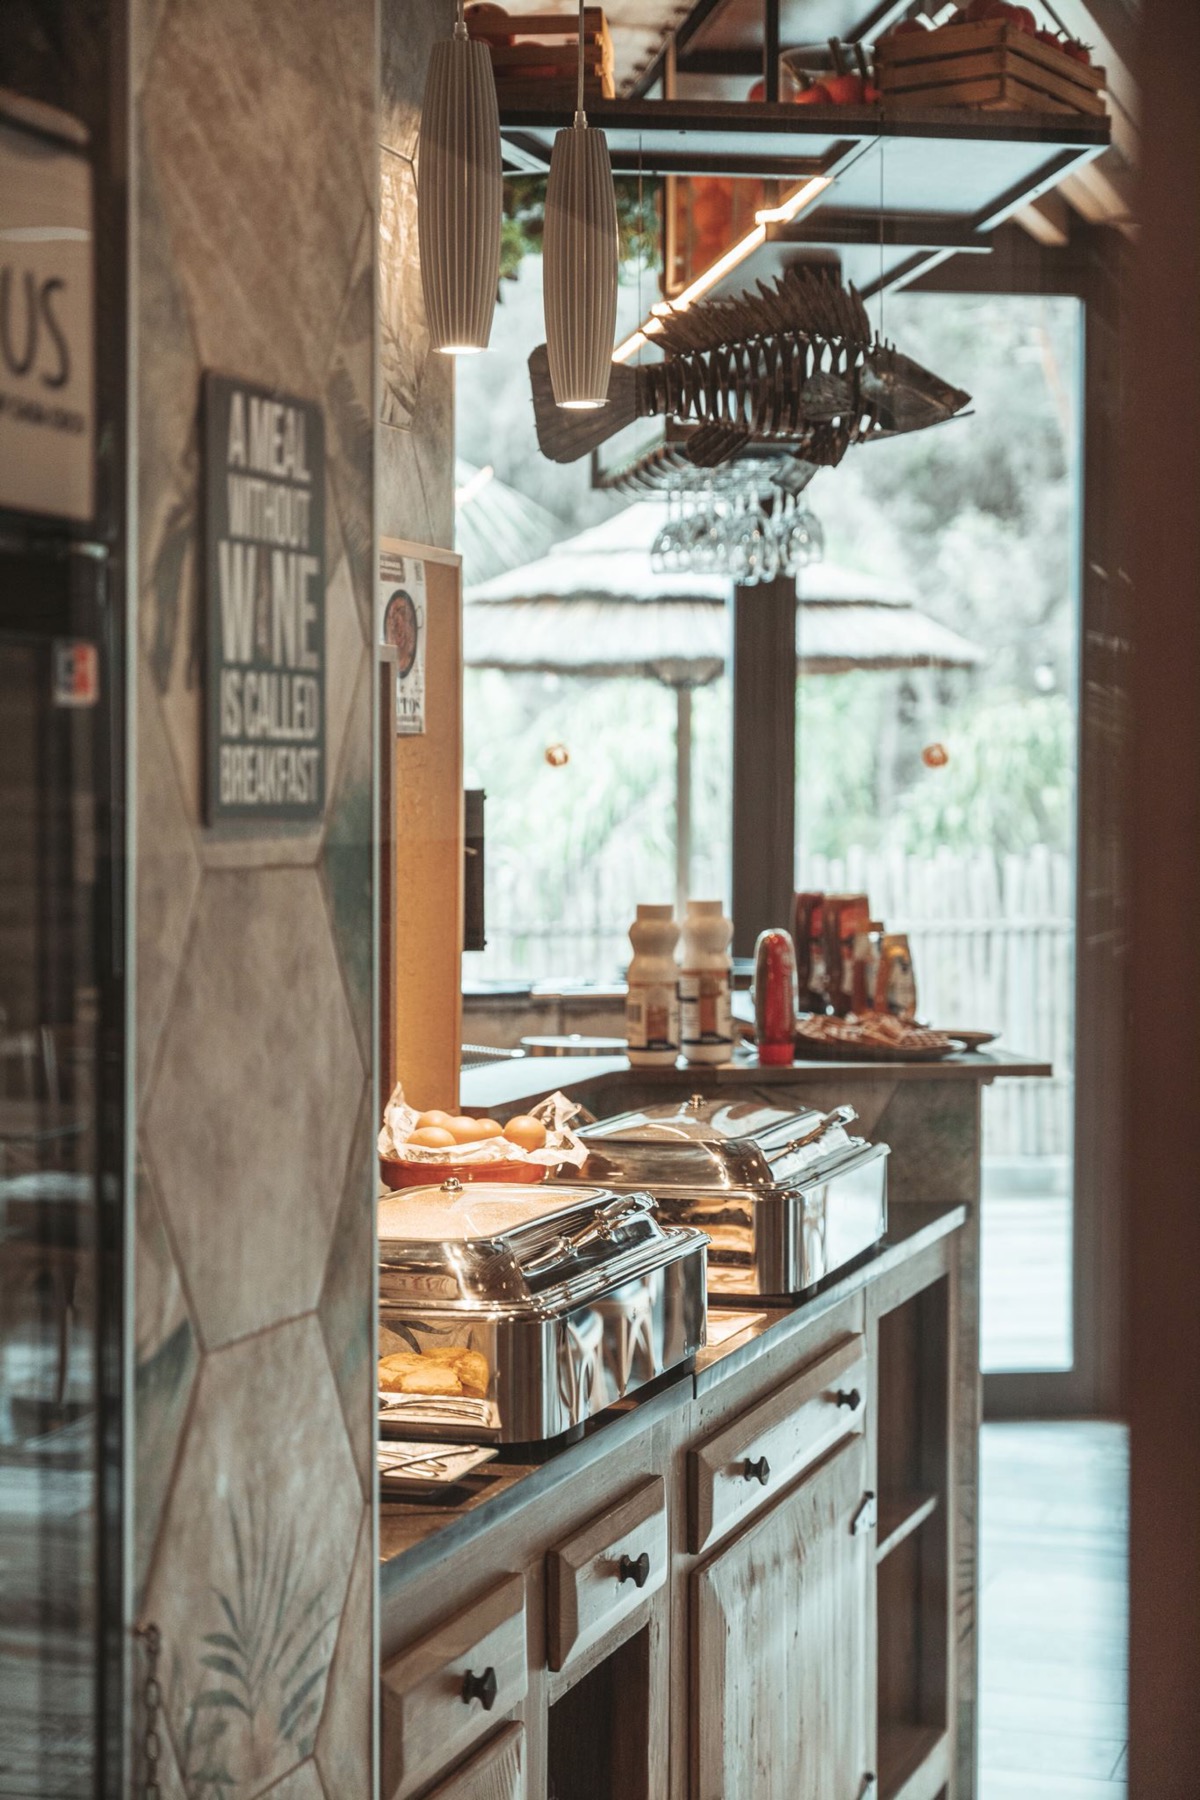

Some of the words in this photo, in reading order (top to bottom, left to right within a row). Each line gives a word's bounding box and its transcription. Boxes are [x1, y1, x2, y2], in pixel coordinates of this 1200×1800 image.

[227, 389, 247, 469] A
[249, 396, 311, 482] MEAL
[219, 539, 320, 669] WINE
[220, 668, 242, 738] IS
[244, 671, 319, 740] CALLED
[220, 744, 320, 805] BREAKFAST
